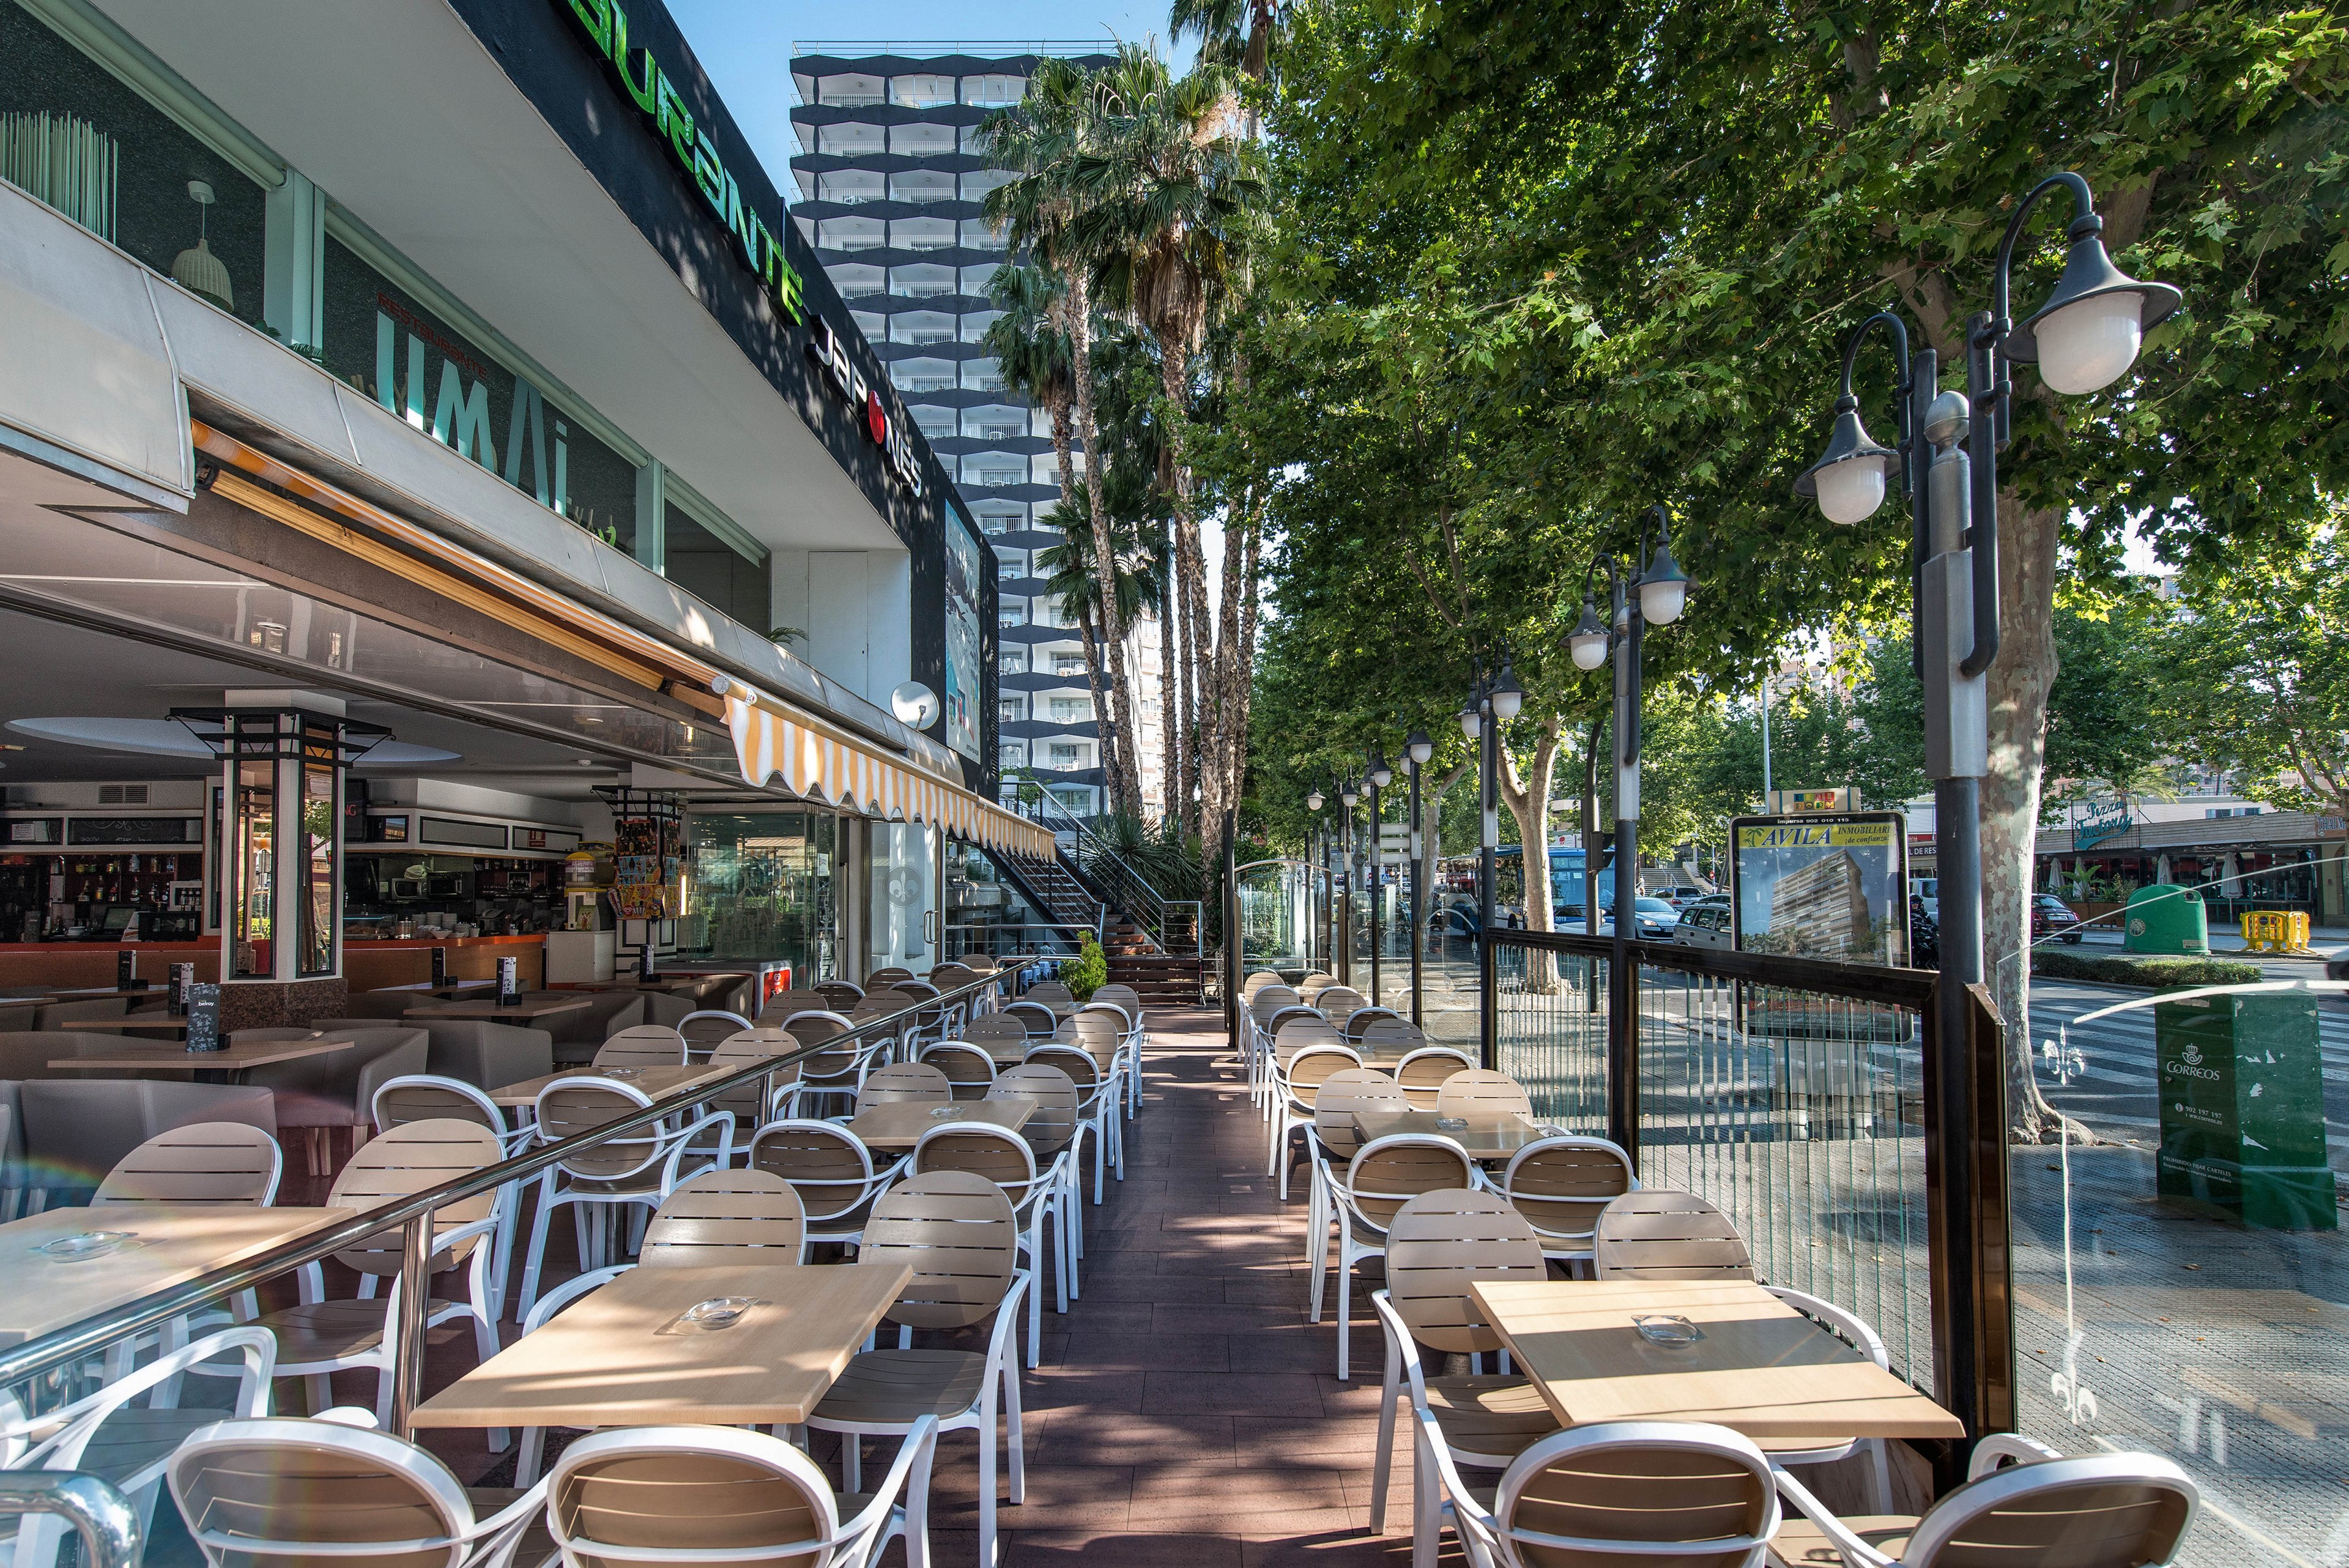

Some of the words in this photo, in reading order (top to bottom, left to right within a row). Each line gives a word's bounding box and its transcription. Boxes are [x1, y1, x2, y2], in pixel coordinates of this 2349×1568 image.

[2087, 800, 2124, 819] Pizza
[2074, 813, 2133, 841] Factory
[2317, 817, 2336, 830] THAI
[1762, 827, 1833, 845] AVILA
[2167, 1061, 2220, 1080] CORREOS
[2185, 1113, 2222, 1125] ww.correos.es
[2163, 1156, 2192, 1167] PROHIBIDO
[2206, 1167, 2232, 1176] CARTELES
[2163, 1162, 2185, 1171] Responsable
